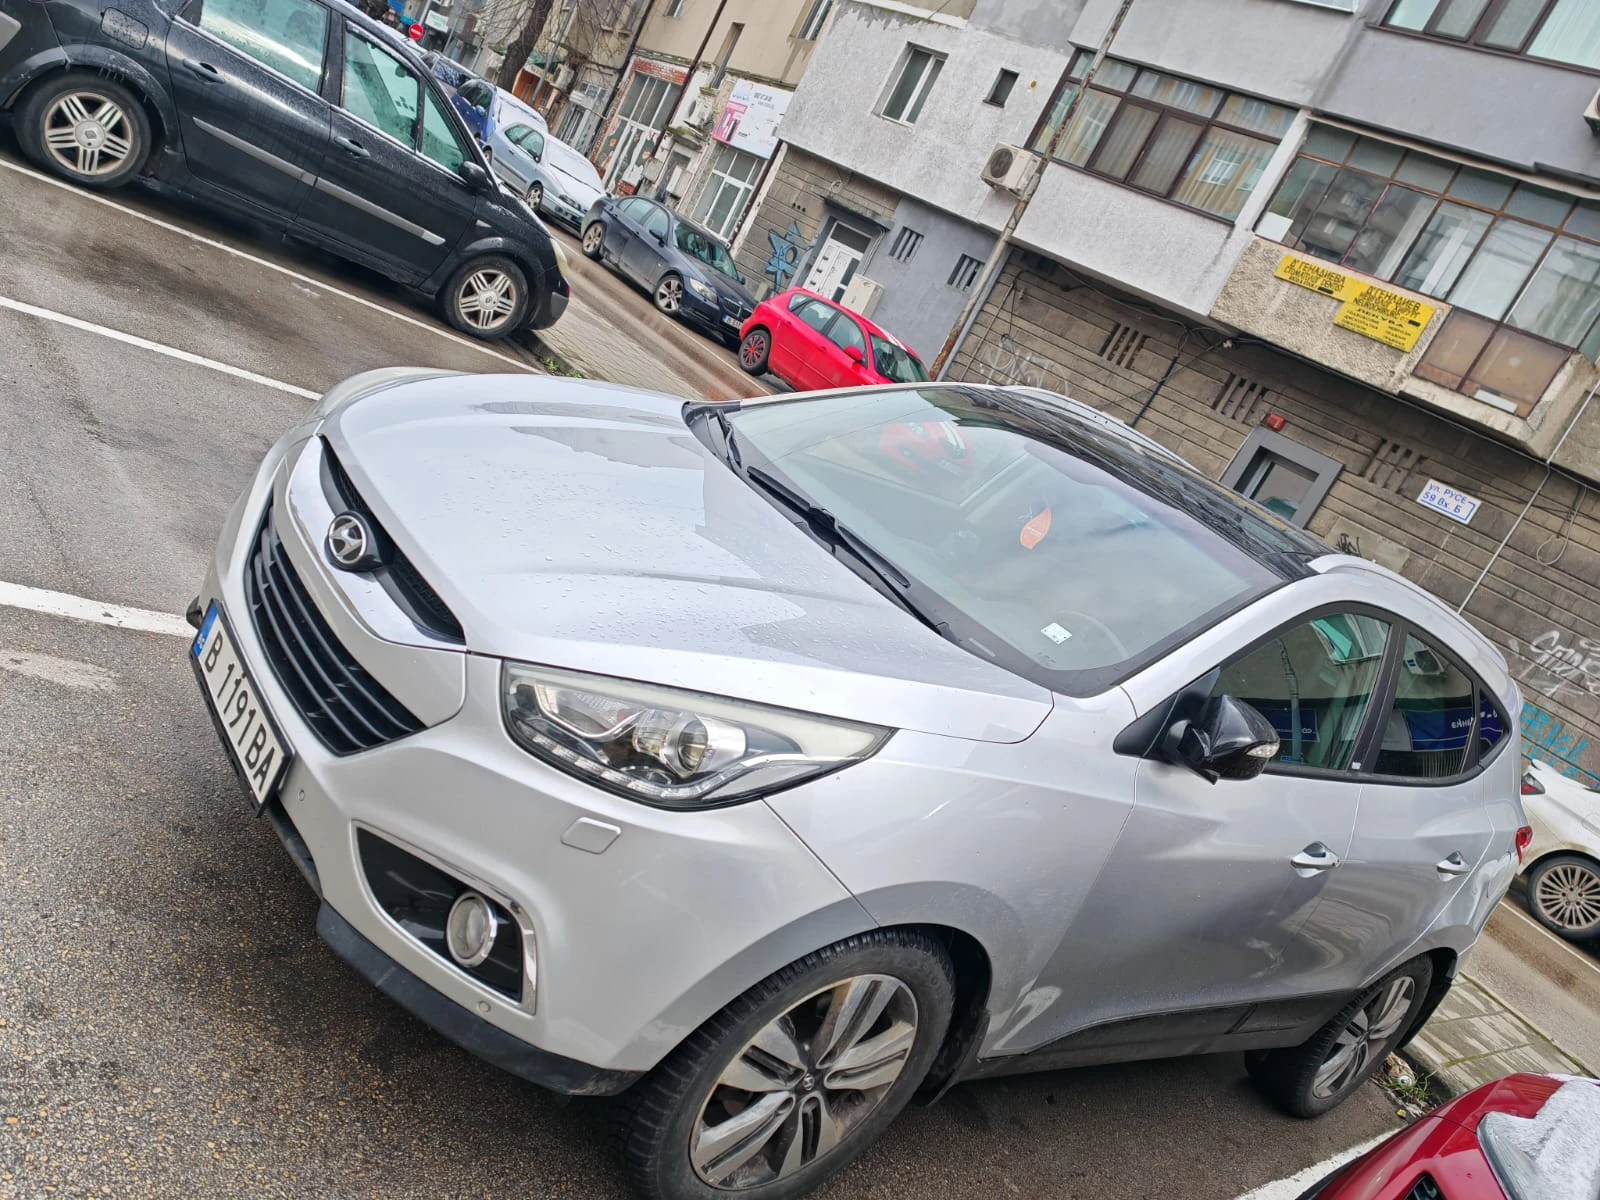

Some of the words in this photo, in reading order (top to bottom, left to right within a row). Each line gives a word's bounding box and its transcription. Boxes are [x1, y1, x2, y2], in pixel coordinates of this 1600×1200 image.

[1423, 492, 1436, 502] 59
[1454, 505, 1463, 513] Б
[1444, 488, 1467, 504] РУСЕ
[205, 630, 223, 673] B
[217, 663, 256, 747] 1191
[245, 723, 275, 792] BA
